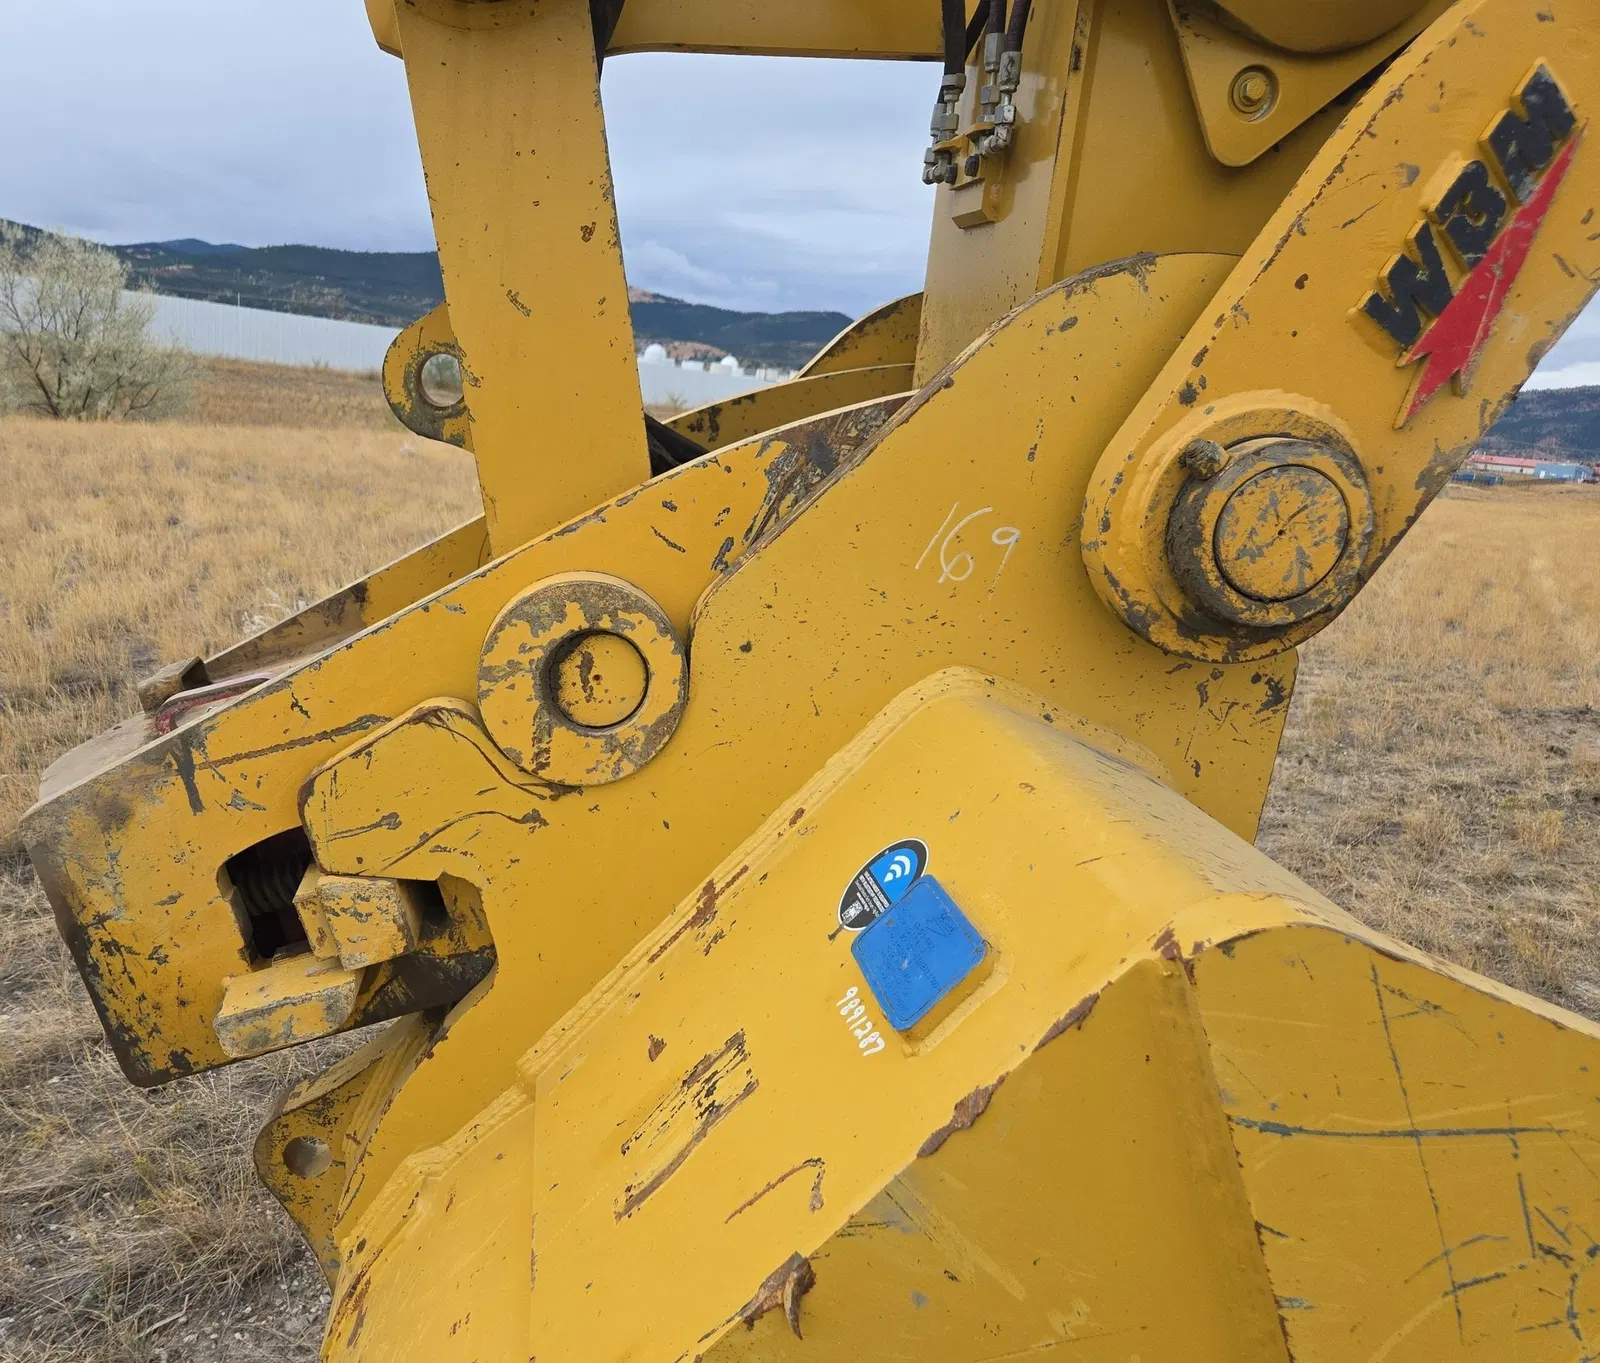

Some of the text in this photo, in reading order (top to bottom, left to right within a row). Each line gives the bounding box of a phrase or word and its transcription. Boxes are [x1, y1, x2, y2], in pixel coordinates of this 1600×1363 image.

[1354, 58, 1577, 350] WBM
[914, 500, 1021, 596] 169
[836, 986, 885, 1056] 9891287
